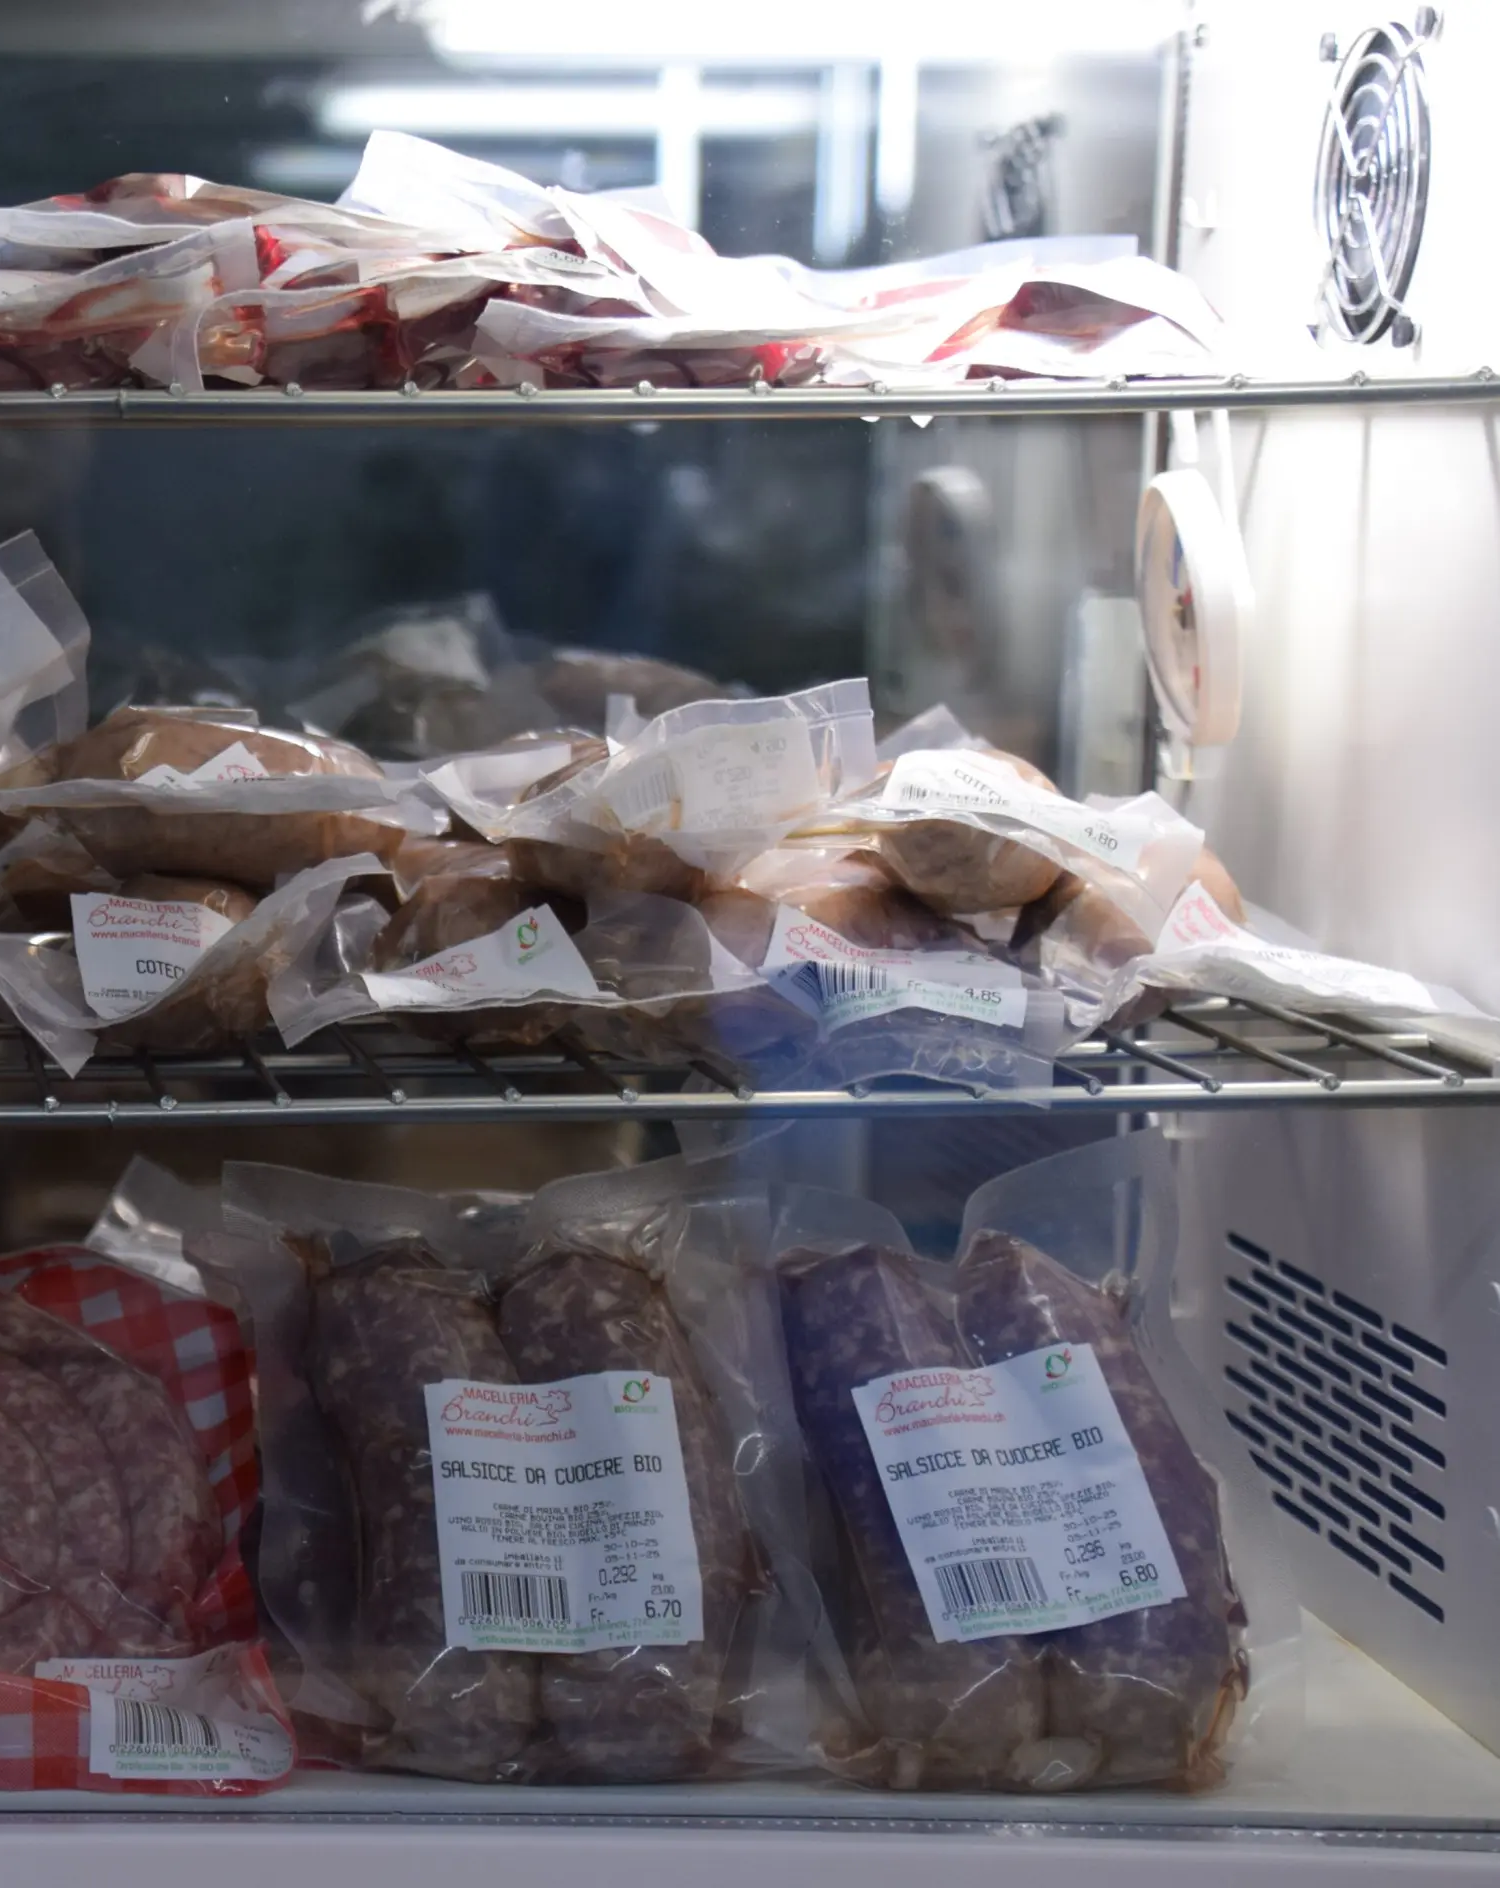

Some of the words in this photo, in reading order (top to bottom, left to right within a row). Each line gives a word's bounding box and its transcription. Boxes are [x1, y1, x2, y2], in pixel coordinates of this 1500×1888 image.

[1084, 826, 1118, 852] 4.80
[87, 904, 183, 929] Branchi
[964, 988, 1002, 1004] 4.85
[891, 1372, 962, 1393] MACELLERIA
[463, 1387, 539, 1405] MACELLERIA
[876, 1386, 967, 1423] Branchi
[441, 1396, 535, 1427] Branchi
[445, 1427, 576, 1444] www.macelleria-branchi.ch
[886, 1450, 966, 1482] SALSICCE
[971, 1449, 992, 1466] DA
[995, 1438, 1066, 1467] CUOCERE
[1071, 1426, 1104, 1451] BIO
[441, 1460, 517, 1483] SALSICCE
[526, 1467, 546, 1485] DA
[555, 1456, 624, 1485] CUOCERE
[634, 1455, 662, 1473] BIO
[454, 1556, 466, 1566] da
[468, 1558, 521, 1568] consumare
[524, 1560, 551, 1570] entro
[504, 1552, 551, 1562] imballato
[1064, 1539, 1106, 1565] 0.296
[599, 1564, 638, 1586] 0.292
[652, 1571, 664, 1582] kg
[1119, 1563, 1159, 1587] 6.80
[590, 1607, 610, 1625] Fr.
[645, 1599, 682, 1618] 6.70
